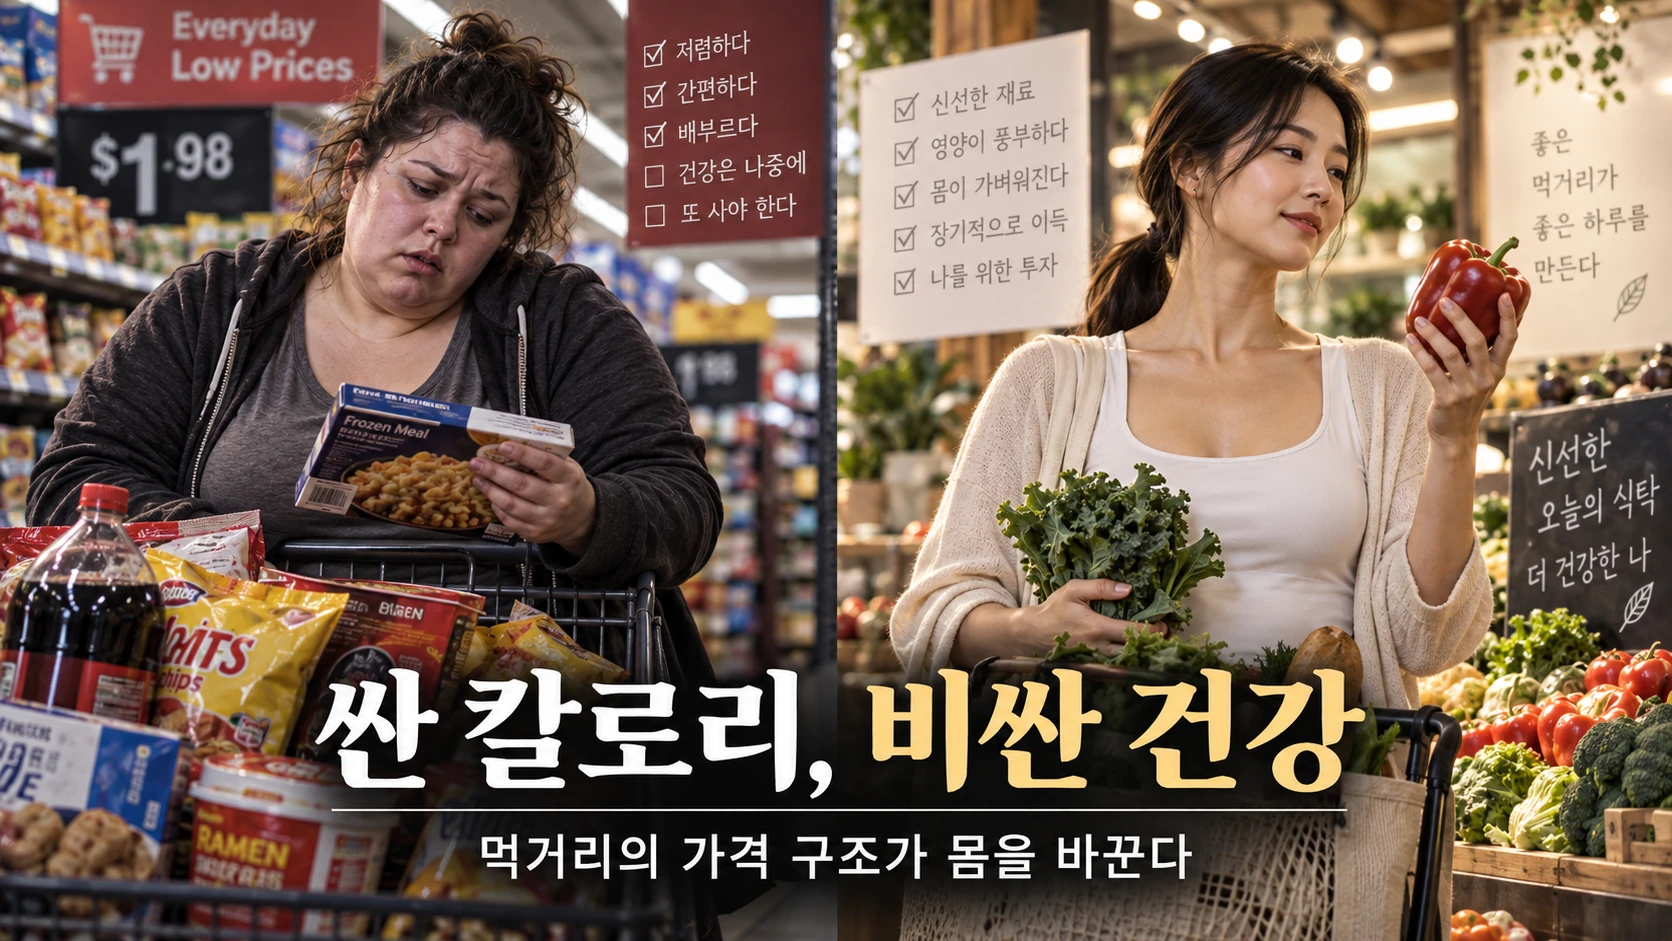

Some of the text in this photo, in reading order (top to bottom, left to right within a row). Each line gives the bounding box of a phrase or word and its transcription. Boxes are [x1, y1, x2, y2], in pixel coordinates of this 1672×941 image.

[175, 13, 313, 45] Everyday
[677, 30, 750, 62] 저렴하다
[174, 51, 351, 80] Low Prices
[678, 72, 757, 104] 간편하다
[932, 80, 1035, 116] 신선한 재료
[679, 114, 758, 144] 배부르다
[932, 118, 1069, 160] 영양이 풍부하다
[1532, 129, 1572, 157] 좋은
[89, 133, 233, 217] $1.98
[679, 150, 805, 185] 건강은 나중에
[931, 163, 1068, 204] 몸이 가벼워진다
[1533, 164, 1618, 198] 먹거리가
[681, 193, 797, 222] 또 사야 한다
[1533, 204, 1648, 241] 좋은 하루를
[931, 208, 1068, 247] 장기적으로 이득
[932, 253, 1058, 289] 나를 위한 투자
[1535, 252, 1600, 283] 만든다
[343, 414, 393, 435] Frozen
[396, 424, 431, 441] Meal
[1529, 427, 1612, 486] 신선한
[1538, 474, 1660, 533] 오늘의 식탁
[1528, 537, 1652, 592] 더 건강한 나
[196, 825, 289, 870] RAMEN
